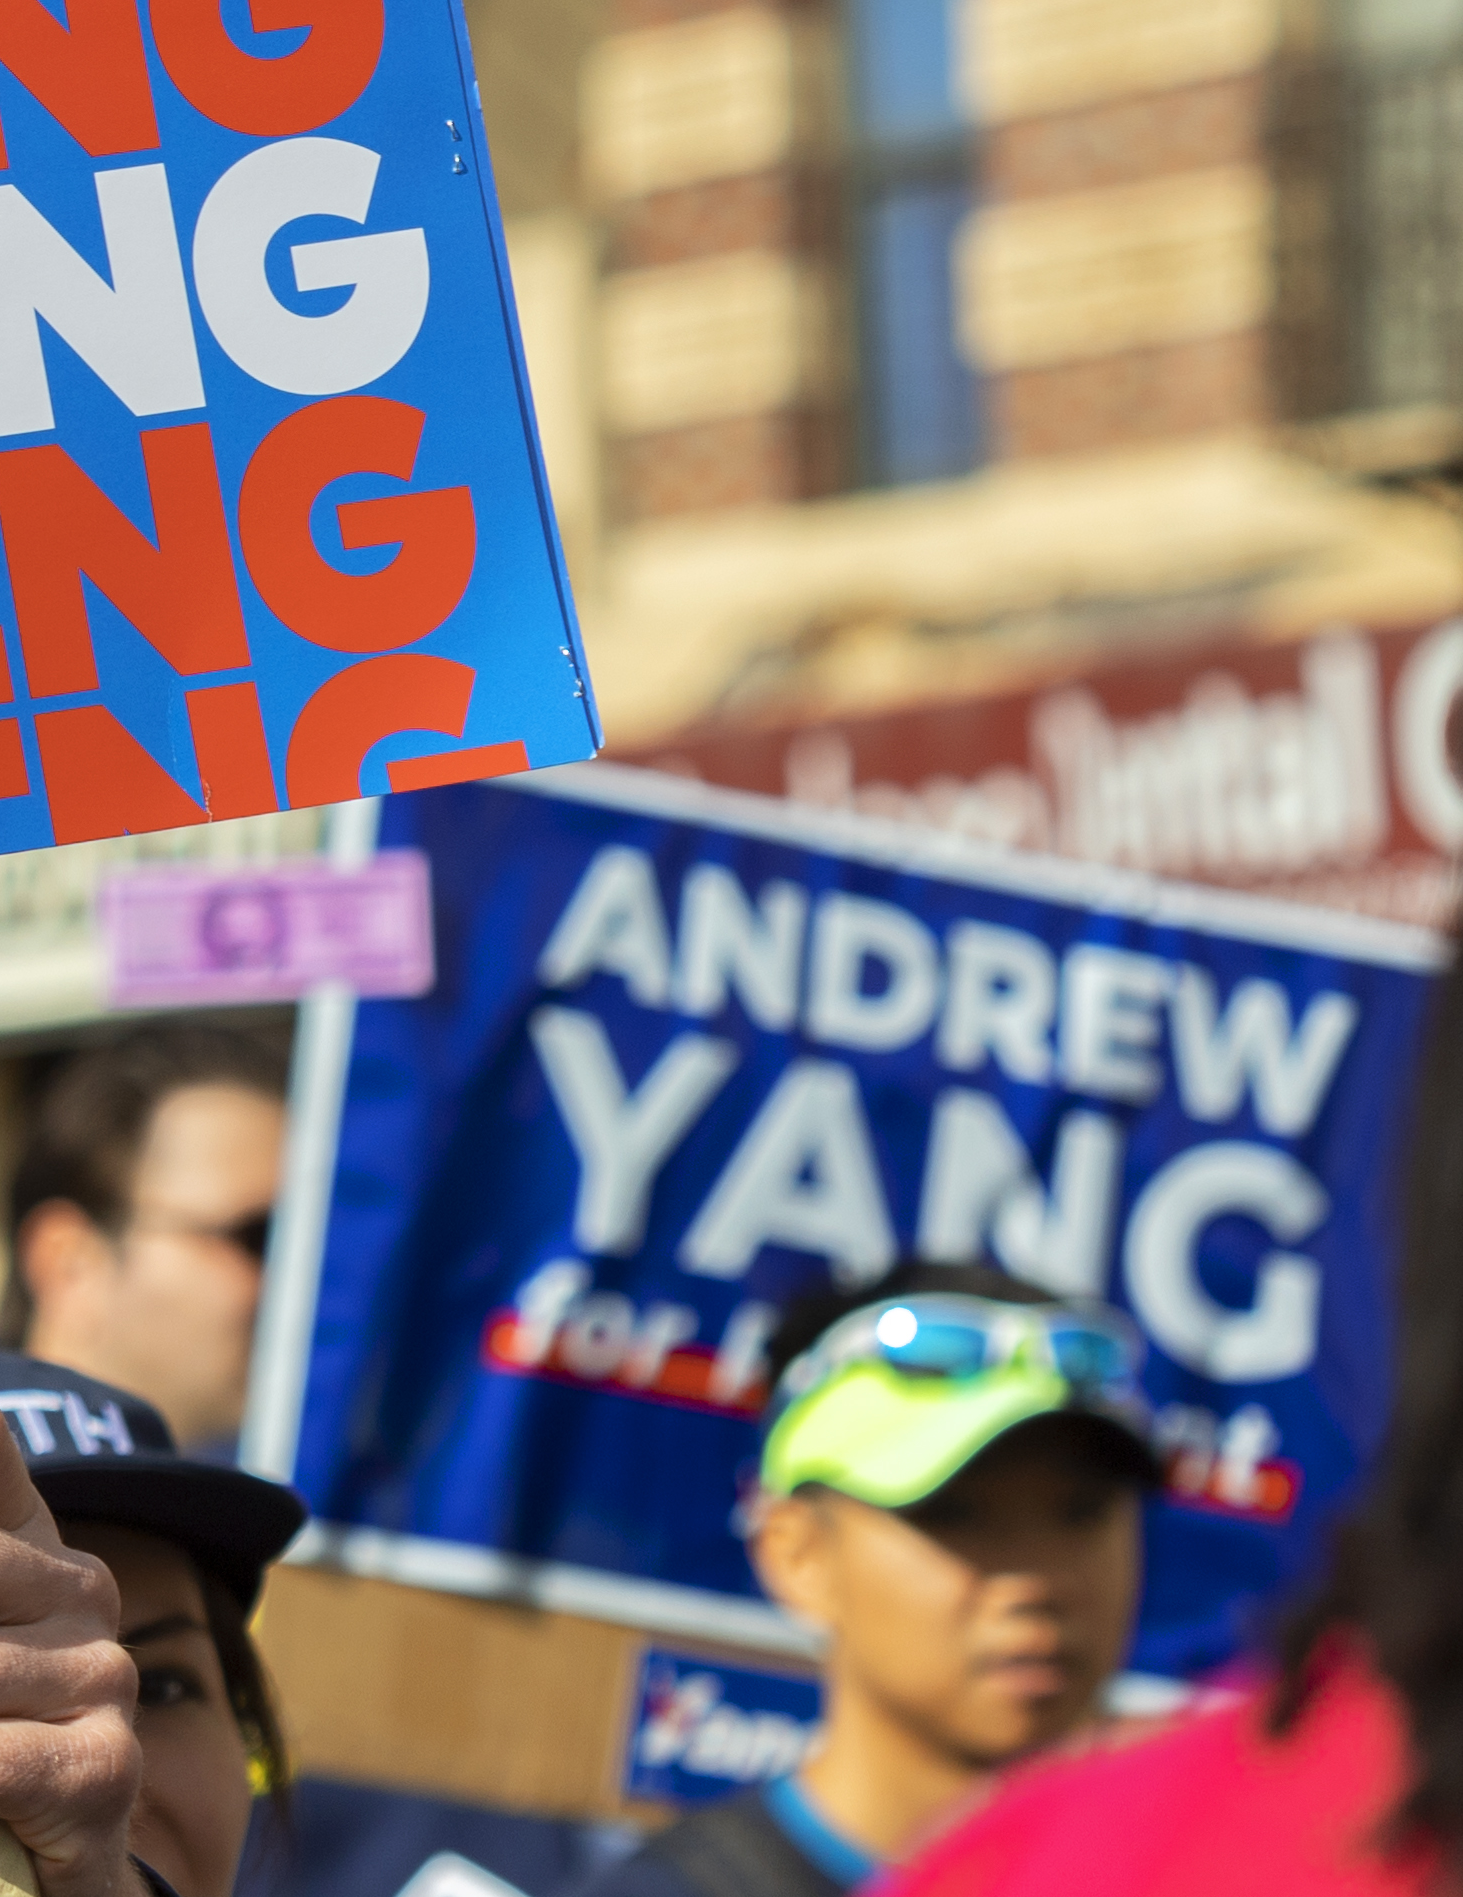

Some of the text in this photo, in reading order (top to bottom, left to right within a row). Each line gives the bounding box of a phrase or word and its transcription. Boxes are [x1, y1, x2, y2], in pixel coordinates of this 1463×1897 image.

[538, 844, 1358, 1138] ANDREW
[513, 1257, 695, 1386] for
[531, 1005, 1328, 1384] YANG
